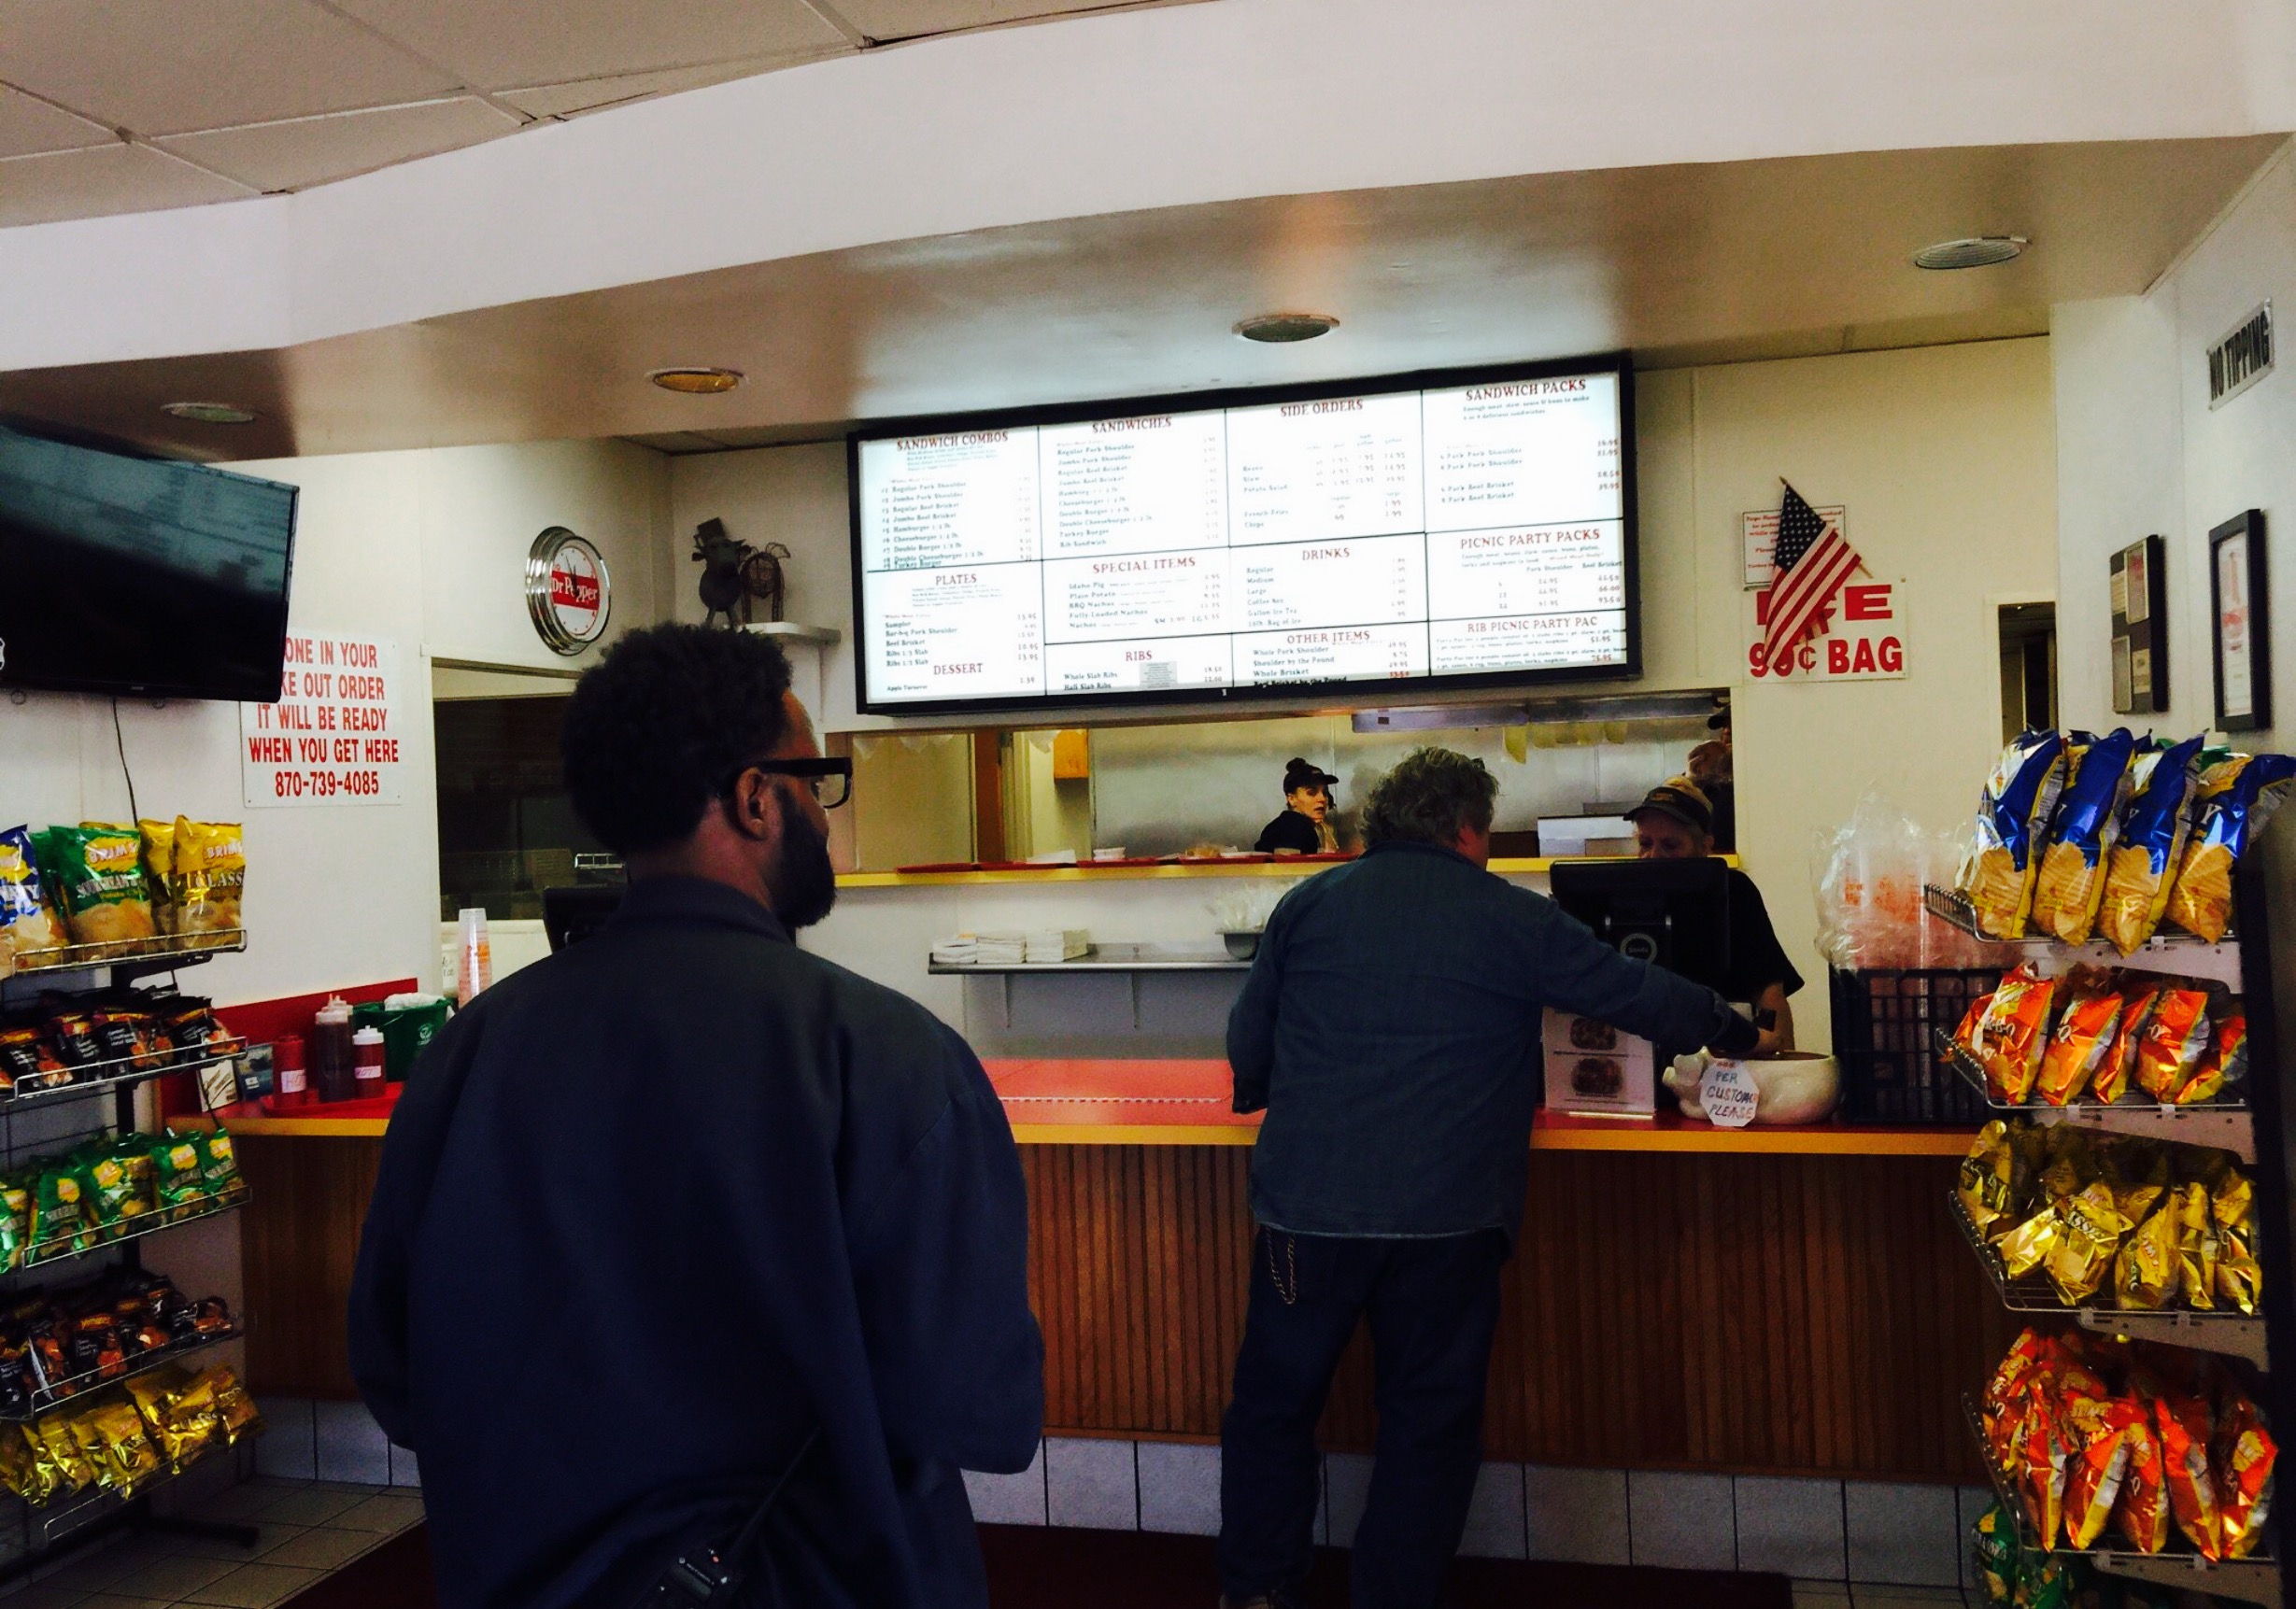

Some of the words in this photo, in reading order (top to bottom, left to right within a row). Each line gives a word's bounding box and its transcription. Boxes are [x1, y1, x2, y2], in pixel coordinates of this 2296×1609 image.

[2209, 345, 2224, 402] NO
[2224, 310, 2270, 389] TIPPING
[1466, 384, 1538, 402] SANDWICH
[1543, 379, 1586, 393] PACKS
[1281, 404, 1309, 417] SIDE
[1312, 399, 1364, 415] ORDERS
[1092, 416, 1171, 434] SANDWICHES
[897, 436, 958, 451] SANDWICH
[961, 431, 1009, 445] COMBOS
[1461, 535, 1505, 549] PICNIC
[1509, 532, 1552, 546] PARTY
[1557, 529, 1600, 542] PACKS
[1302, 547, 1350, 561] DRINKS
[1093, 560, 1150, 573] SPECIAL
[1155, 557, 1196, 570] ITEMS
[552, 577, 563, 594] Dr
[936, 573, 977, 586] PLATES
[1467, 623, 1486, 632] RIB
[1491, 620, 1529, 631] PICNIC
[1534, 618, 1571, 628] PARTY
[1575, 616, 1597, 627] PAC
[1287, 633, 1328, 643] OTHER
[1333, 630, 1370, 642] ITEMS
[284, 637, 314, 664] ONE
[319, 640, 334, 665] IN
[340, 642, 378, 669] YOUR
[1126, 651, 1152, 661] RIBS
[1828, 636, 1903, 674] BAG
[934, 663, 983, 675] DESSERT
[281, 671, 297, 697] KE
[304, 671, 332, 698] OUT
[338, 674, 385, 700] ORDER
[258, 703, 270, 729] IT
[277, 704, 312, 730] WILL
[318, 706, 336, 730] BE
[342, 707, 388, 731] READY
[248, 737, 292, 763] WHEN
[298, 738, 327, 763] YOU
[333, 738, 359, 763] GET
[365, 739, 399, 763] HERE
[275, 770, 379, 797] 870-739-4085
[1716, 1071, 1738, 1084] PER
[1708, 1103, 1754, 1120] PLEASE
